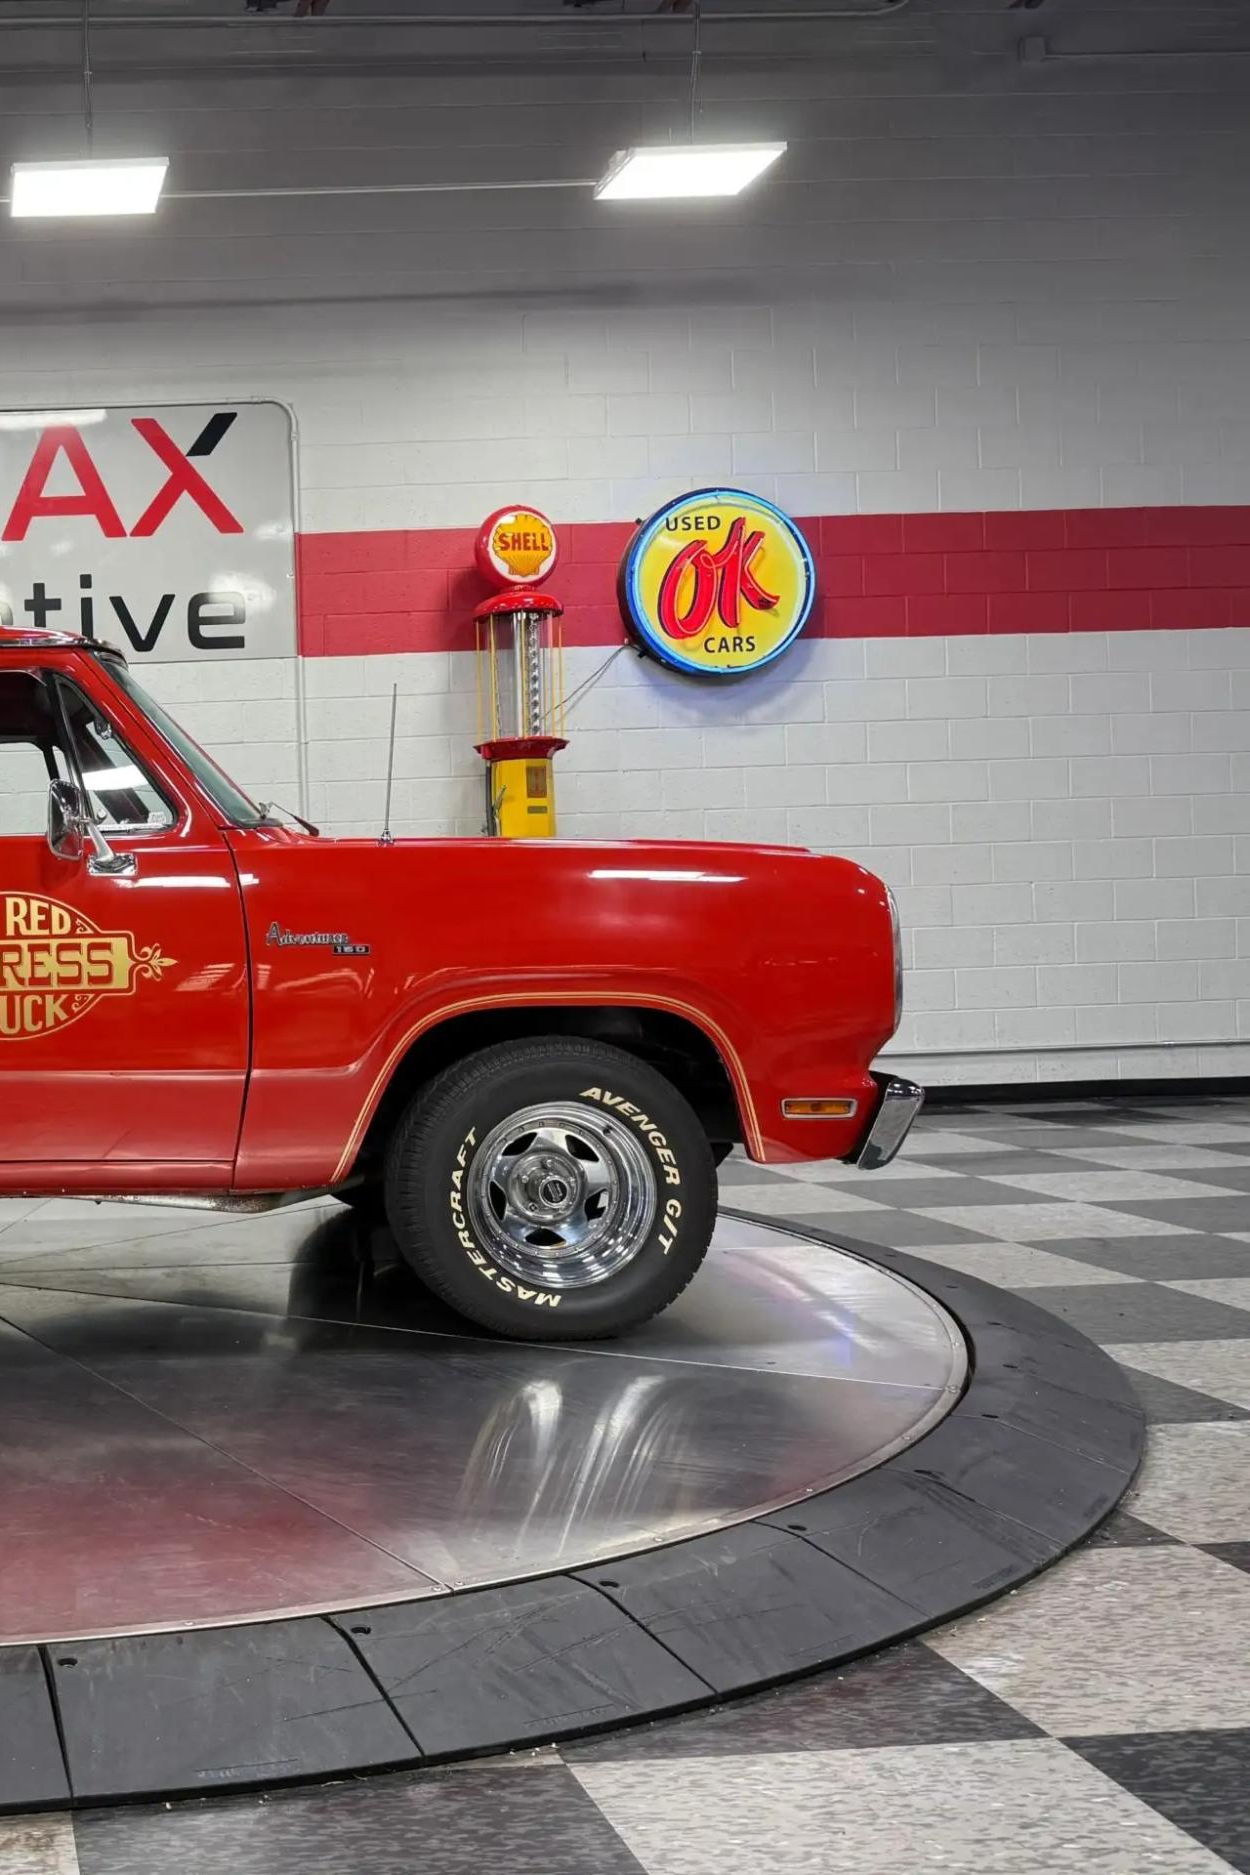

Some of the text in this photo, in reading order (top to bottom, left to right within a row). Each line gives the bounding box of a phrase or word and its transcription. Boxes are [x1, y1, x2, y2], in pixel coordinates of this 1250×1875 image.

[499, 531, 549, 552] SHELL
[665, 515, 721, 532] USED
[657, 516, 781, 640] OK
[703, 635, 756, 653] CARS
[5, 896, 71, 936] RED
[579, 1086, 682, 1255] AVENGER G/T
[449, 1126, 562, 1307] MASTERCRAFT
